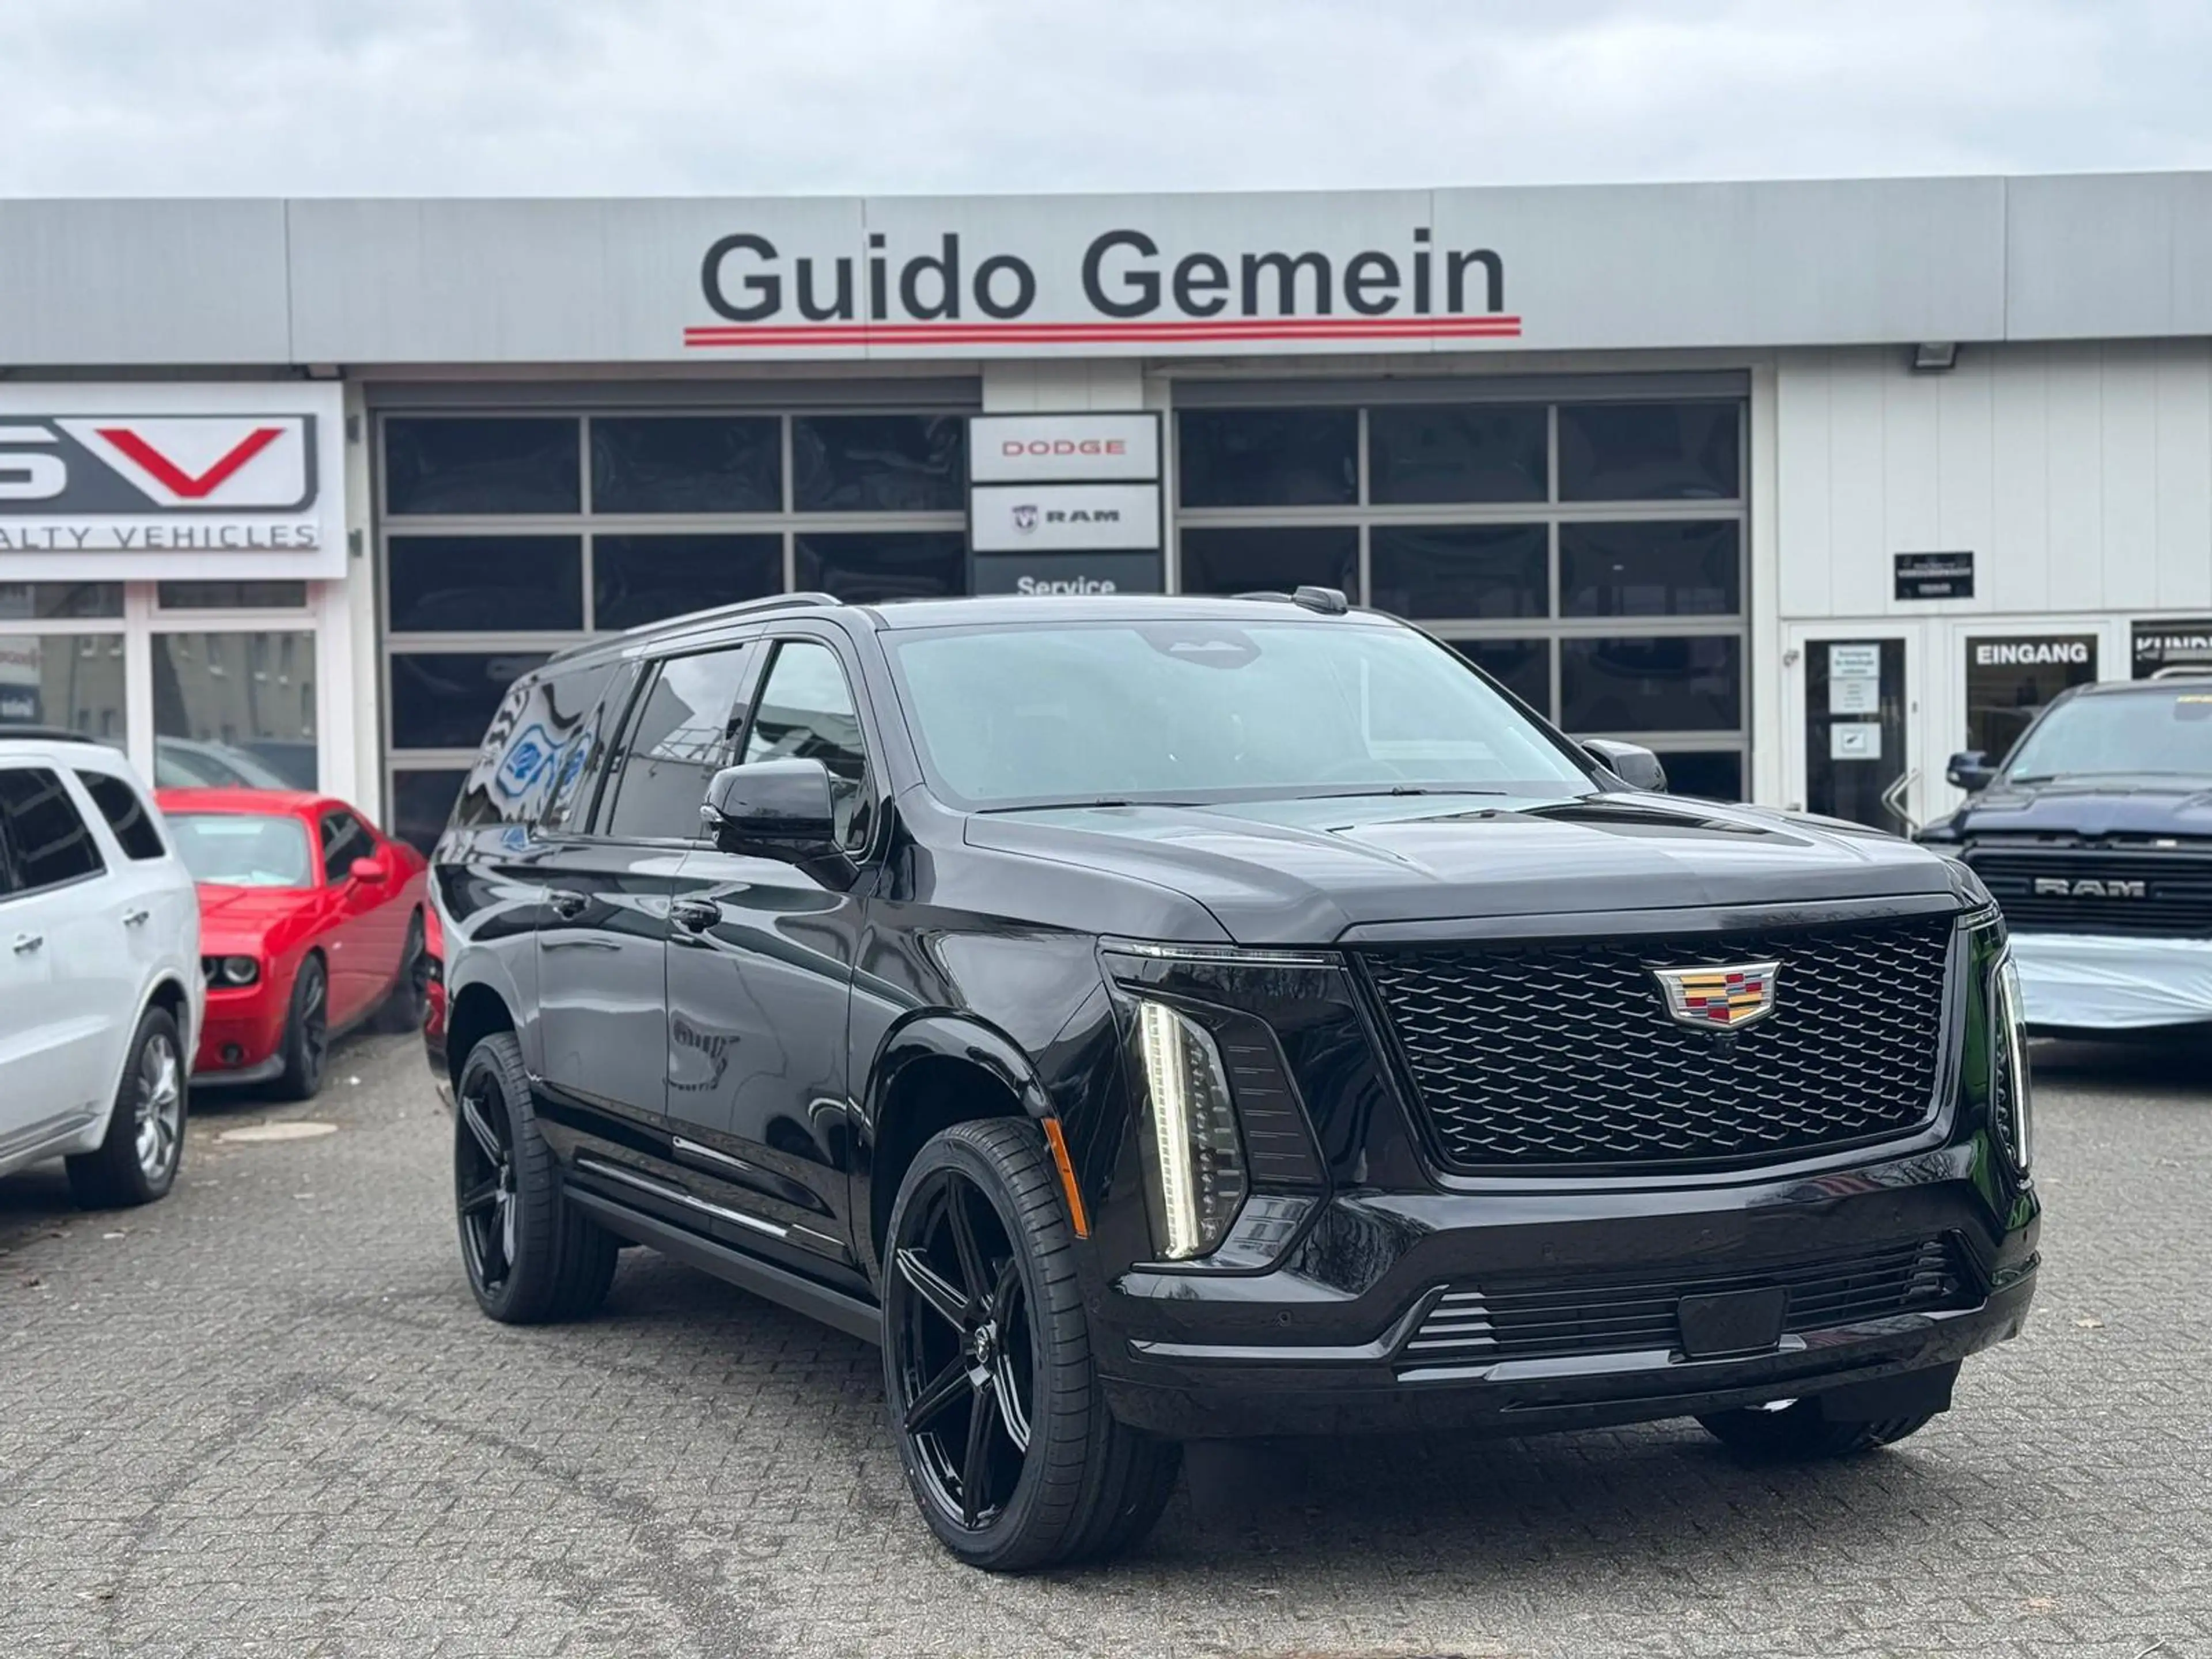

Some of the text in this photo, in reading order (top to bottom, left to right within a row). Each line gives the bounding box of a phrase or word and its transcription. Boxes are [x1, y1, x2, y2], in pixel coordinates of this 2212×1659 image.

[700, 227, 1504, 323] Guido Gemein
[1002, 440, 1126, 457] DODGE
[1046, 509, 1121, 524] RAM
[112, 525, 315, 549] VEHICLES
[1017, 575, 1116, 596] Service
[1976, 642, 2088, 665] EINGANG
[2035, 877, 2146, 897] RAM
